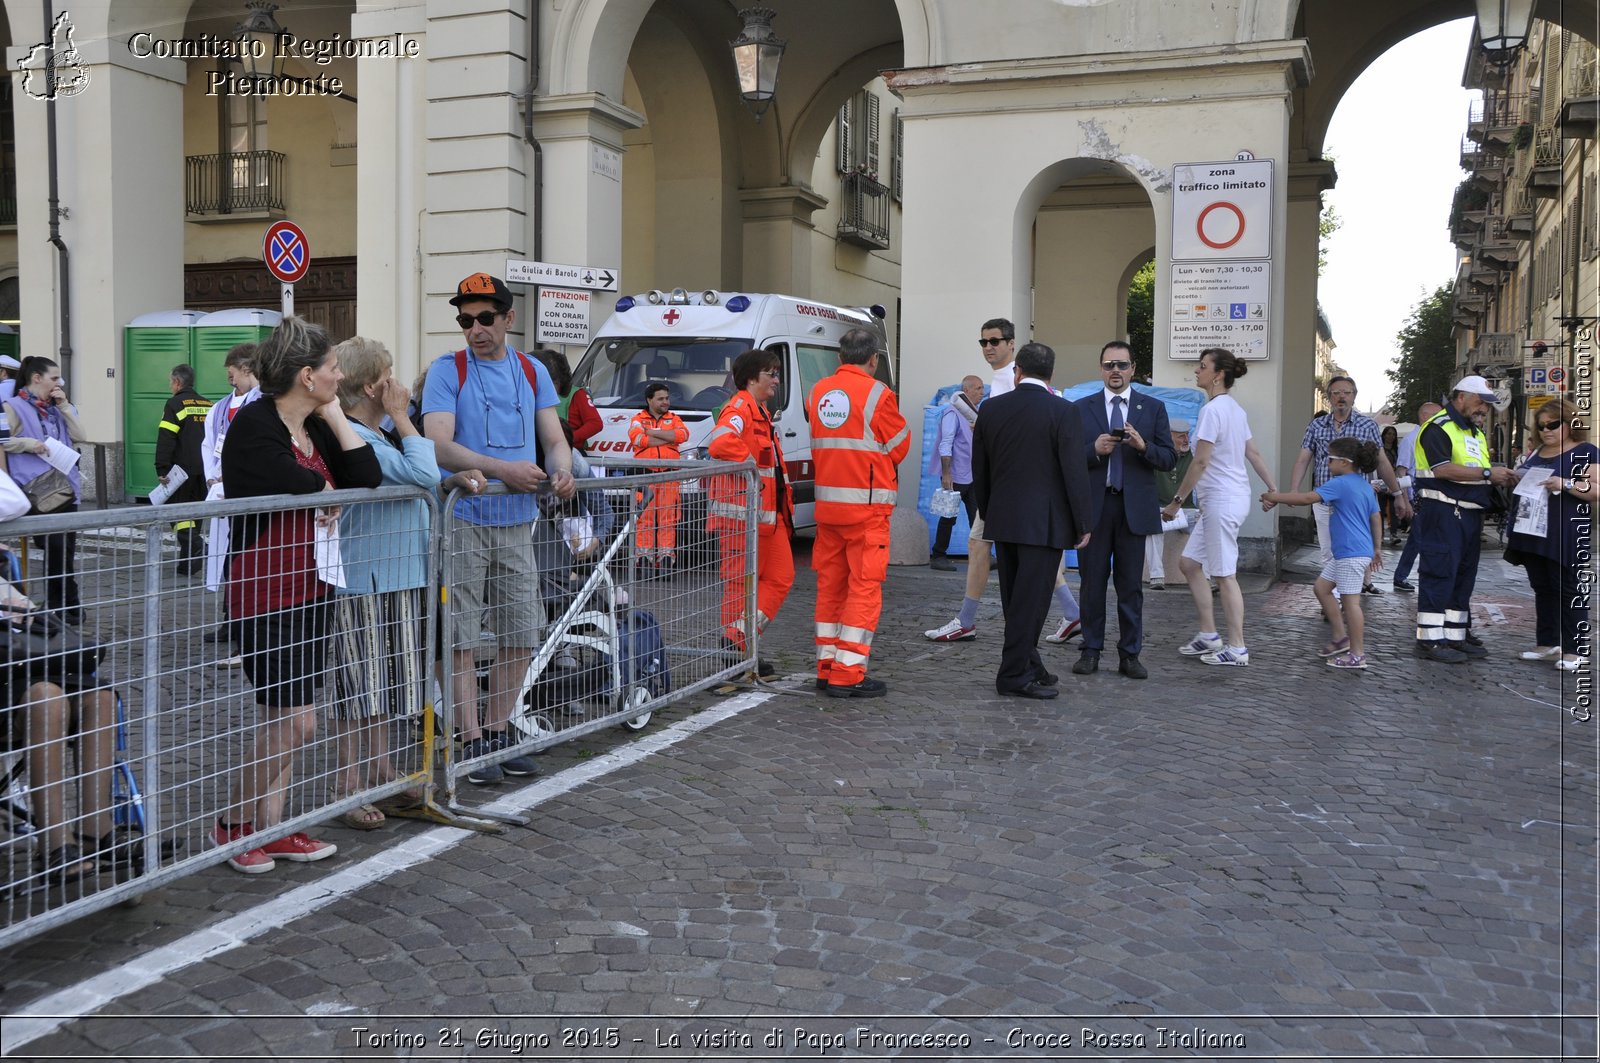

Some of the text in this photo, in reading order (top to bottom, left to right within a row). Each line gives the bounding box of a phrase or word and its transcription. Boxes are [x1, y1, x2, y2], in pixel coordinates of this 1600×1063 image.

[1179, 180, 1266, 191] traffico limitato
[522, 266, 543, 274] Giulia
[555, 269, 578, 278] Barolo
[542, 291, 589, 301] ATTENZIONE
[796, 304, 817, 316] CROCE
[817, 308, 837, 320] ROSSA
[543, 331, 584, 339] MODIFICATI
